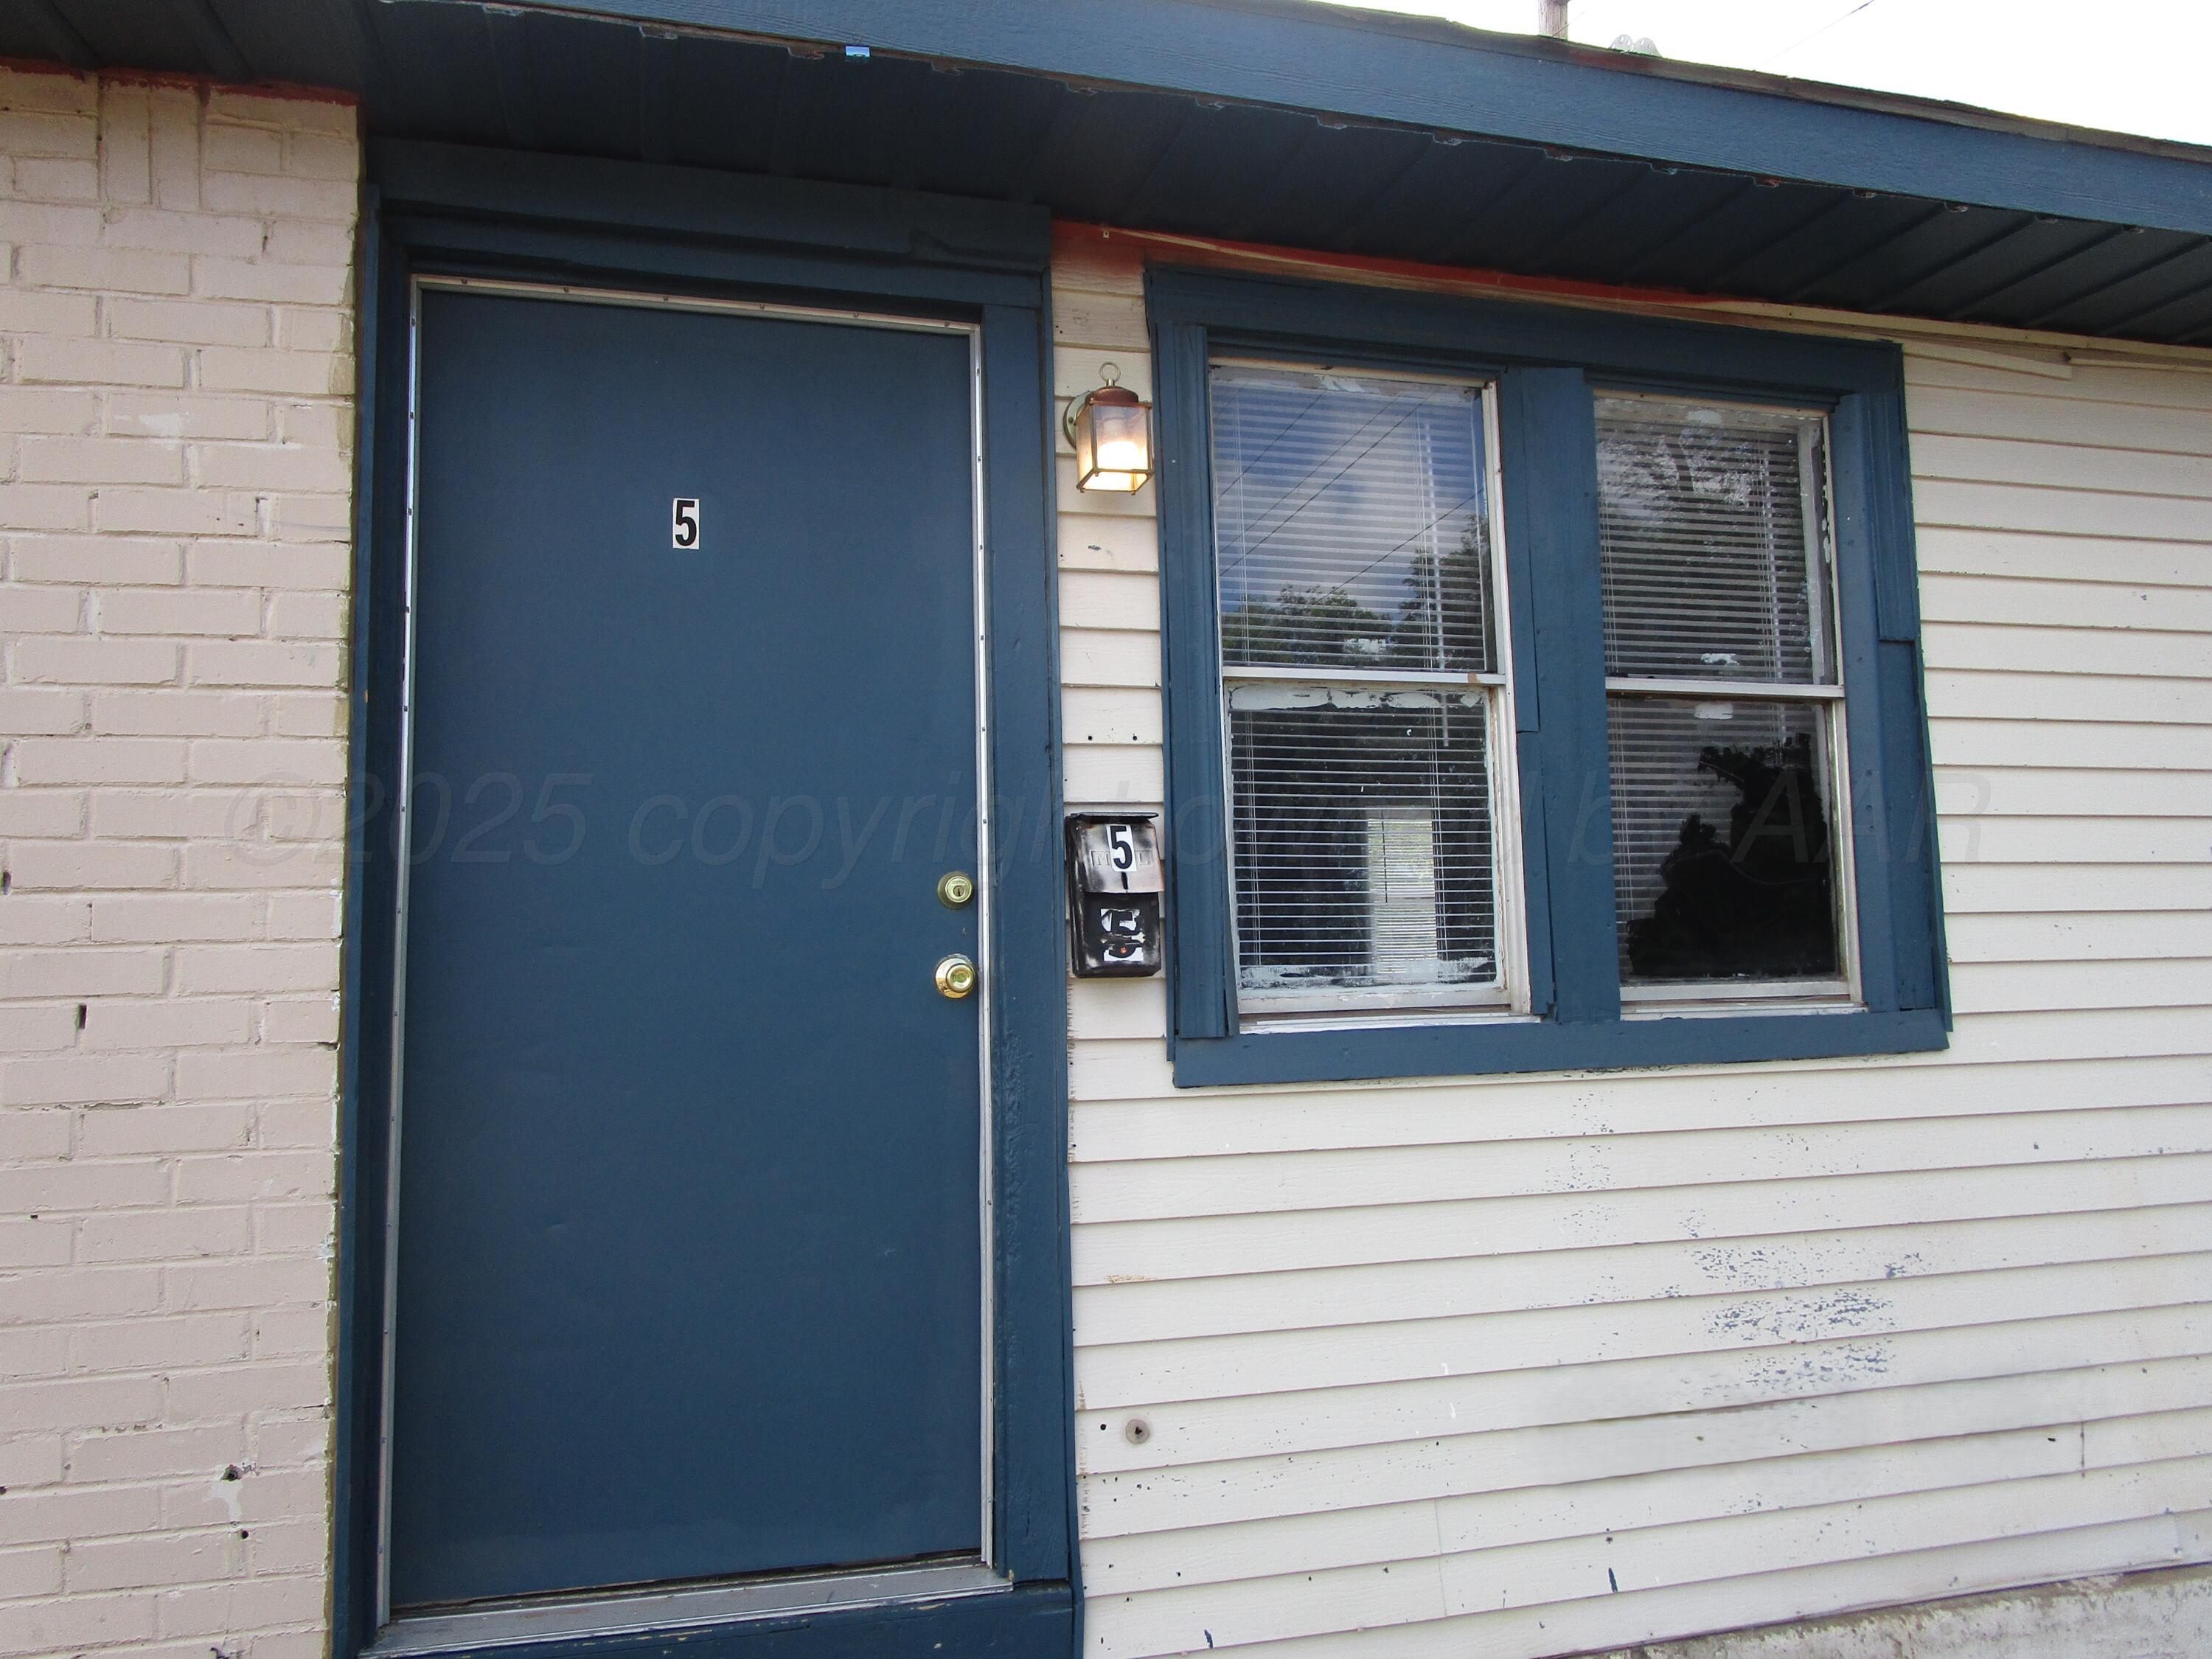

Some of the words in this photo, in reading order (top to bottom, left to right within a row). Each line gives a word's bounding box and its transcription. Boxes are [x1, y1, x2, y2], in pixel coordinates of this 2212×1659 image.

[675, 500, 697, 546] 5
[1096, 852, 1152, 866] ML
[1110, 825, 1133, 869] 5
